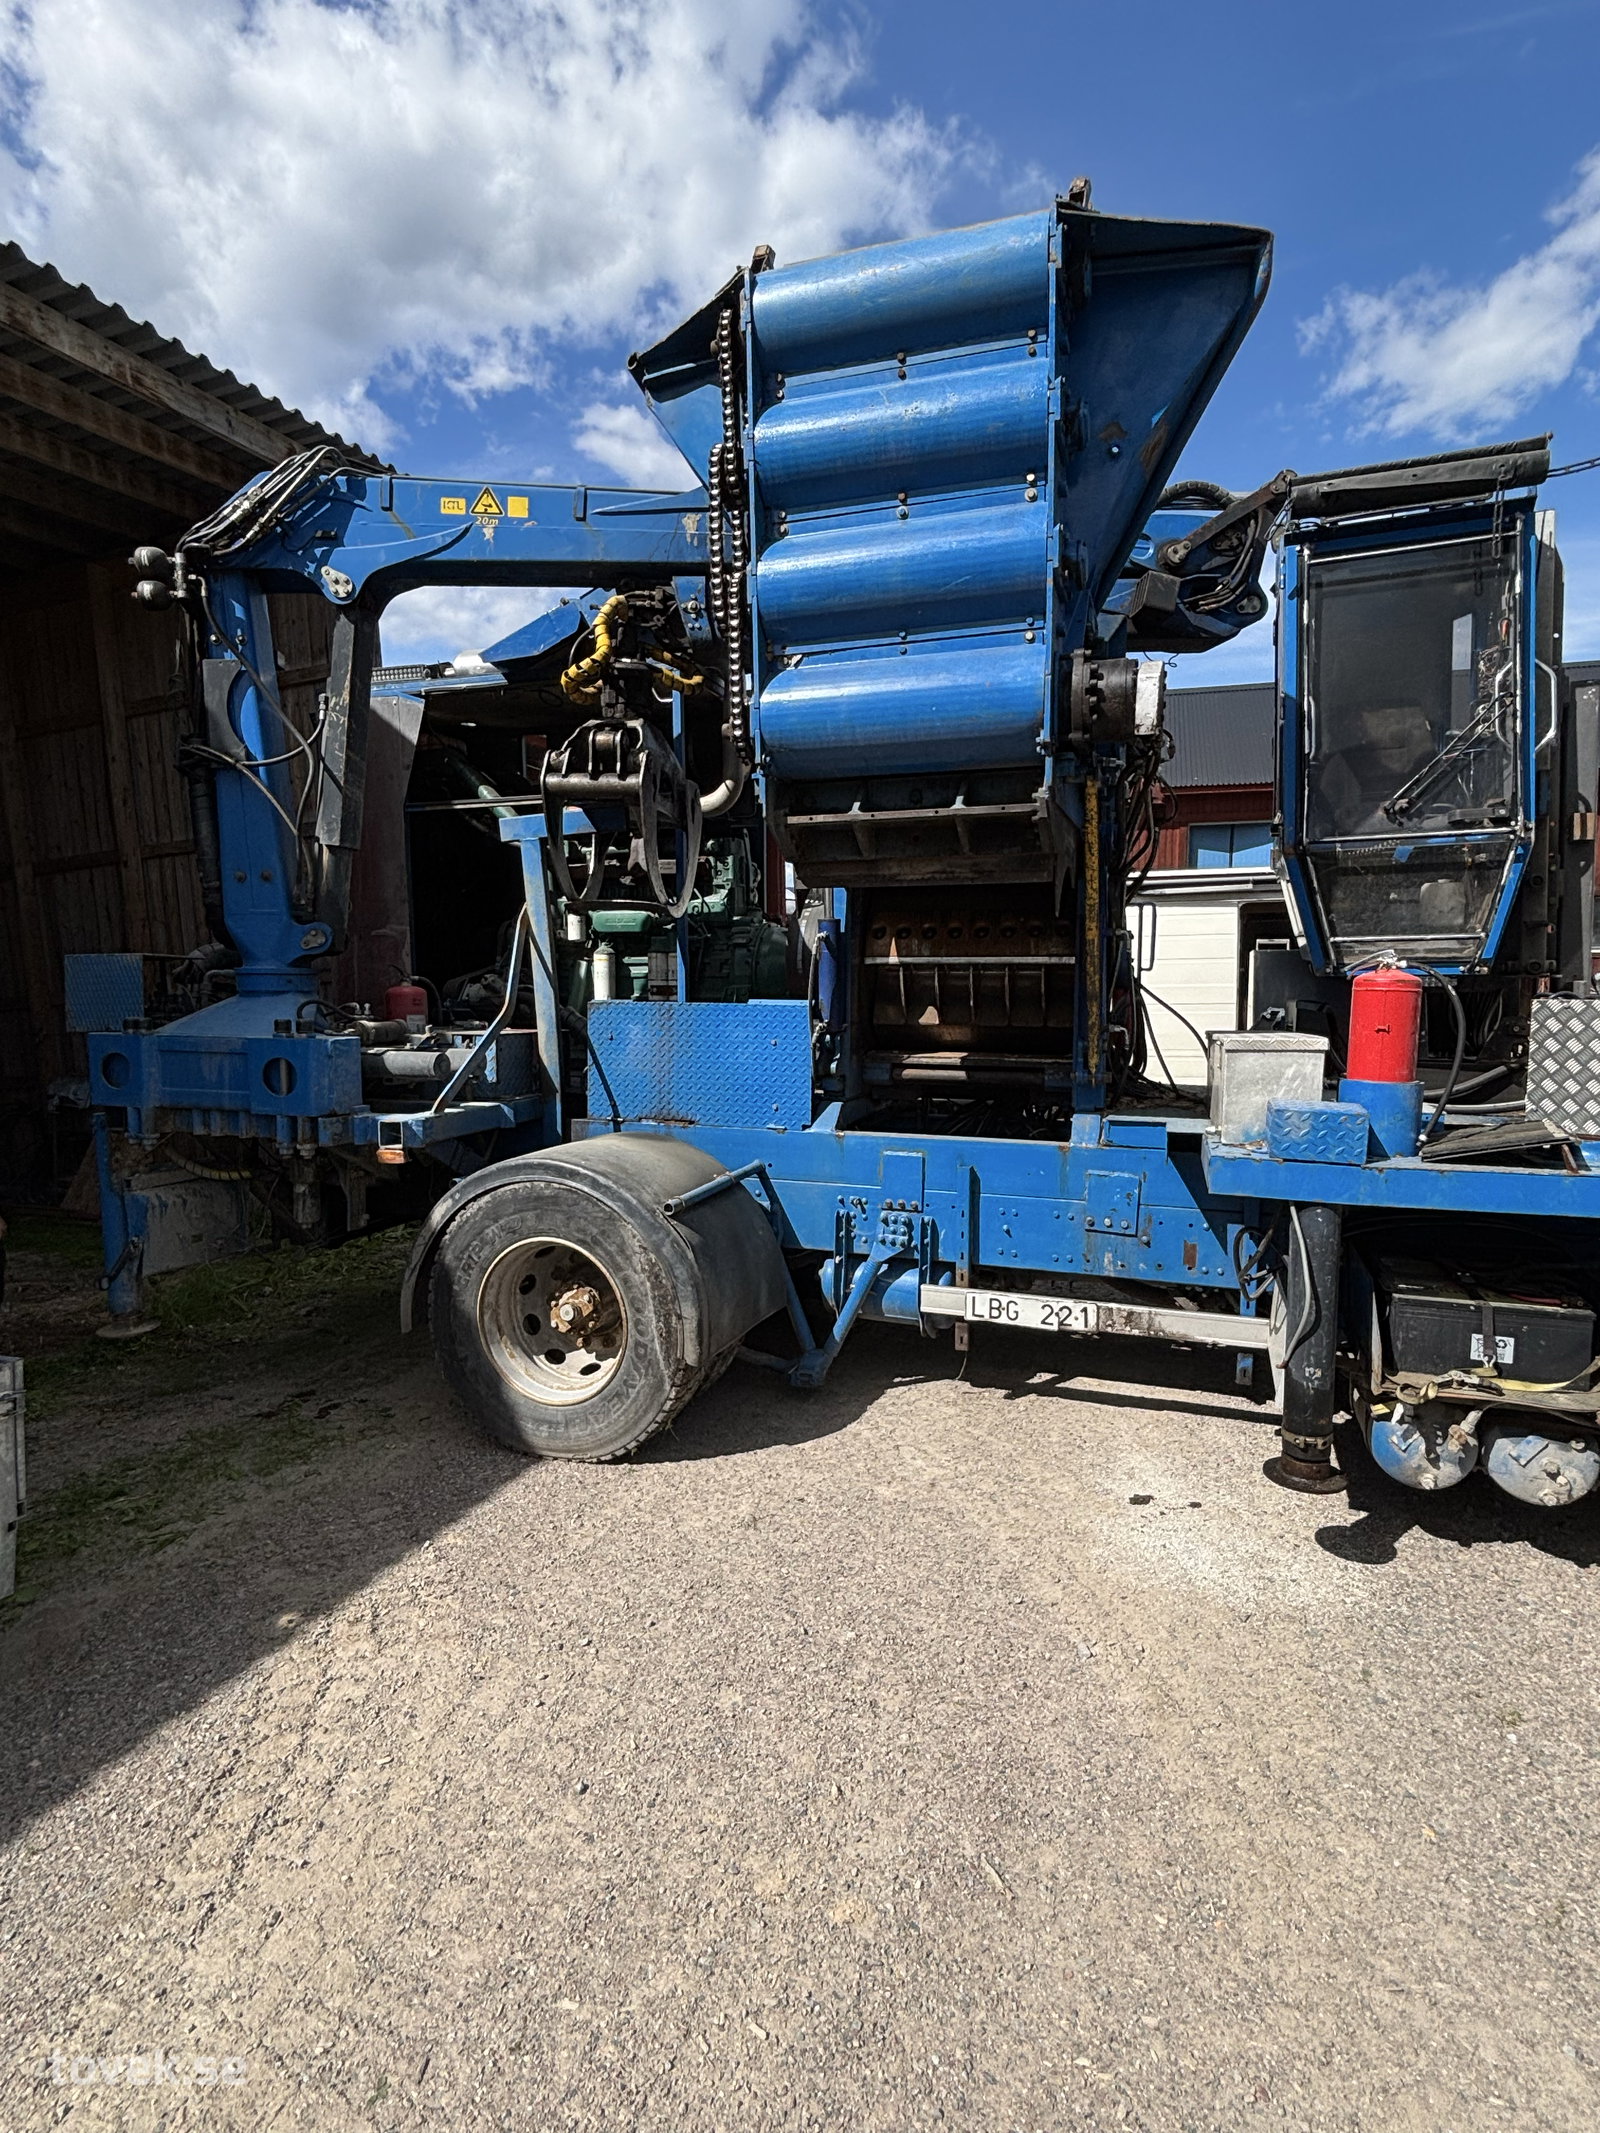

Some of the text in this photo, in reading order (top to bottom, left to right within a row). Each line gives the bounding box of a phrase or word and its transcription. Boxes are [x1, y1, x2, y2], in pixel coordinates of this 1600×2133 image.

[475, 516, 499, 525] 20m
[971, 1296, 1089, 1329] LBG 221
